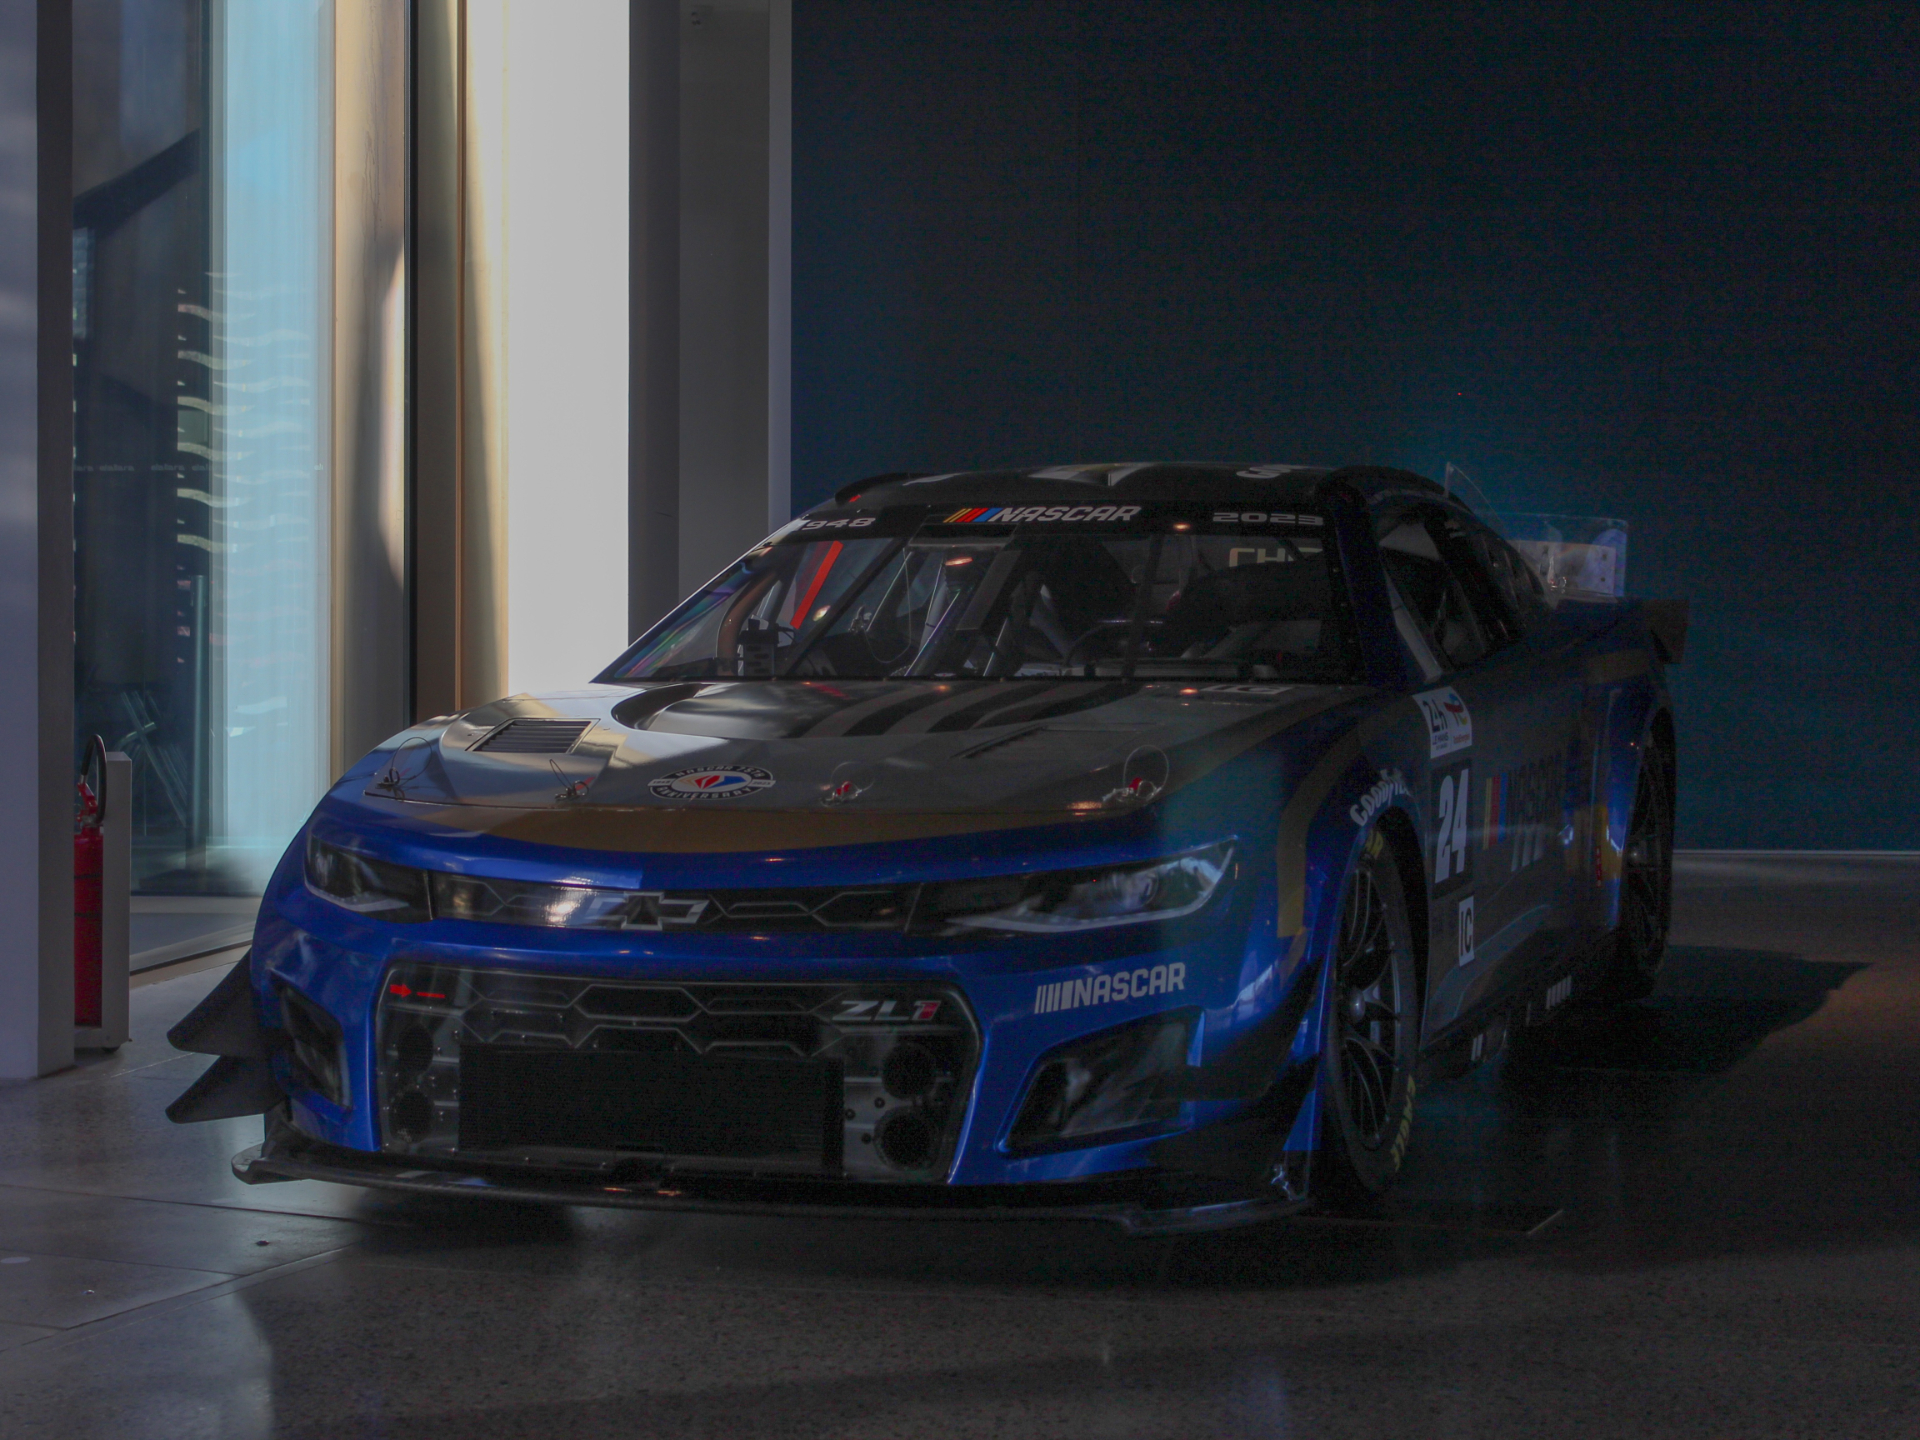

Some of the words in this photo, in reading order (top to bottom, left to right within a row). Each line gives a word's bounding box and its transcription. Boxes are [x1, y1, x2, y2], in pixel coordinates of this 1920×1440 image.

[987, 506, 1142, 522] NASCAR
[1212, 512, 1324, 526] 2023
[675, 766, 733, 777] NASCAR
[656, 786, 753, 799] ANNIVERSARY
[1435, 768, 1469, 884] 24
[1073, 962, 1186, 1007] NASCAR
[832, 1000, 941, 1021] ZL1
